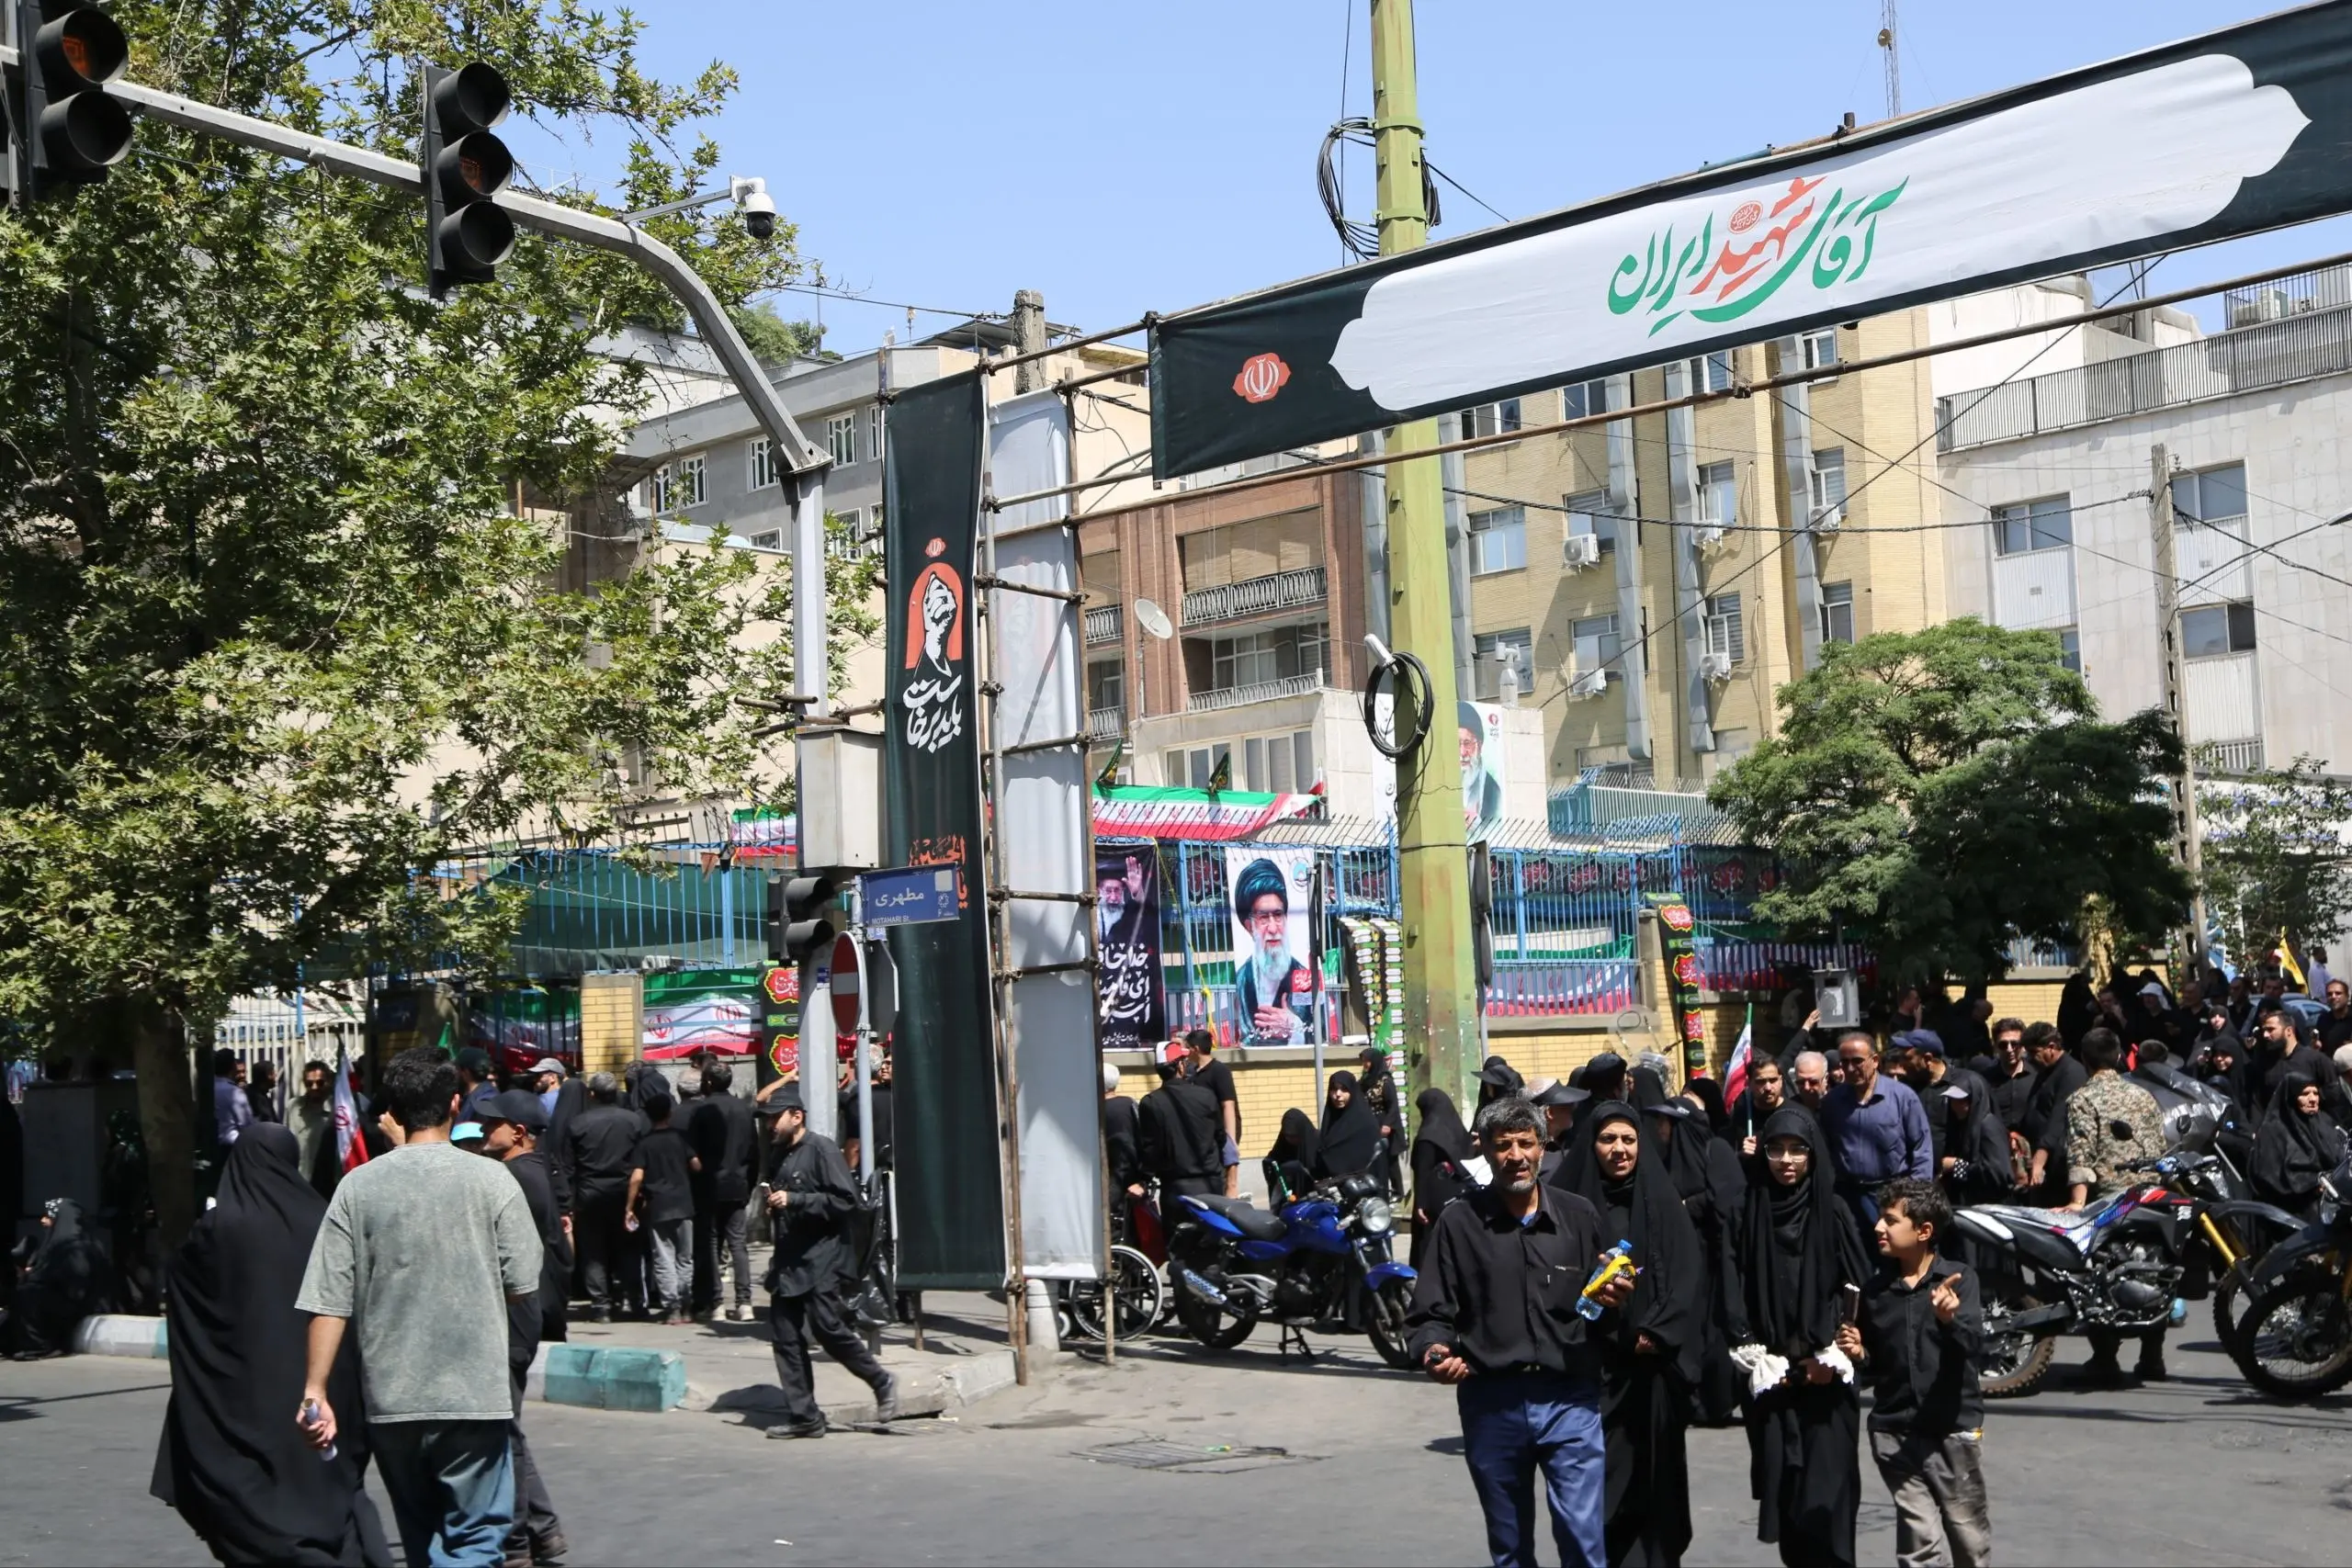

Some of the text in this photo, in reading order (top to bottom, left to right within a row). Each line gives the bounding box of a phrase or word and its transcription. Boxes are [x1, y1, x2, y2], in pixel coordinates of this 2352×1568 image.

[1608, 175, 1910, 338] آقای شهید ایران
[876, 887, 924, 907] مطهری
[872, 916, 902, 925] MOTAHARI
